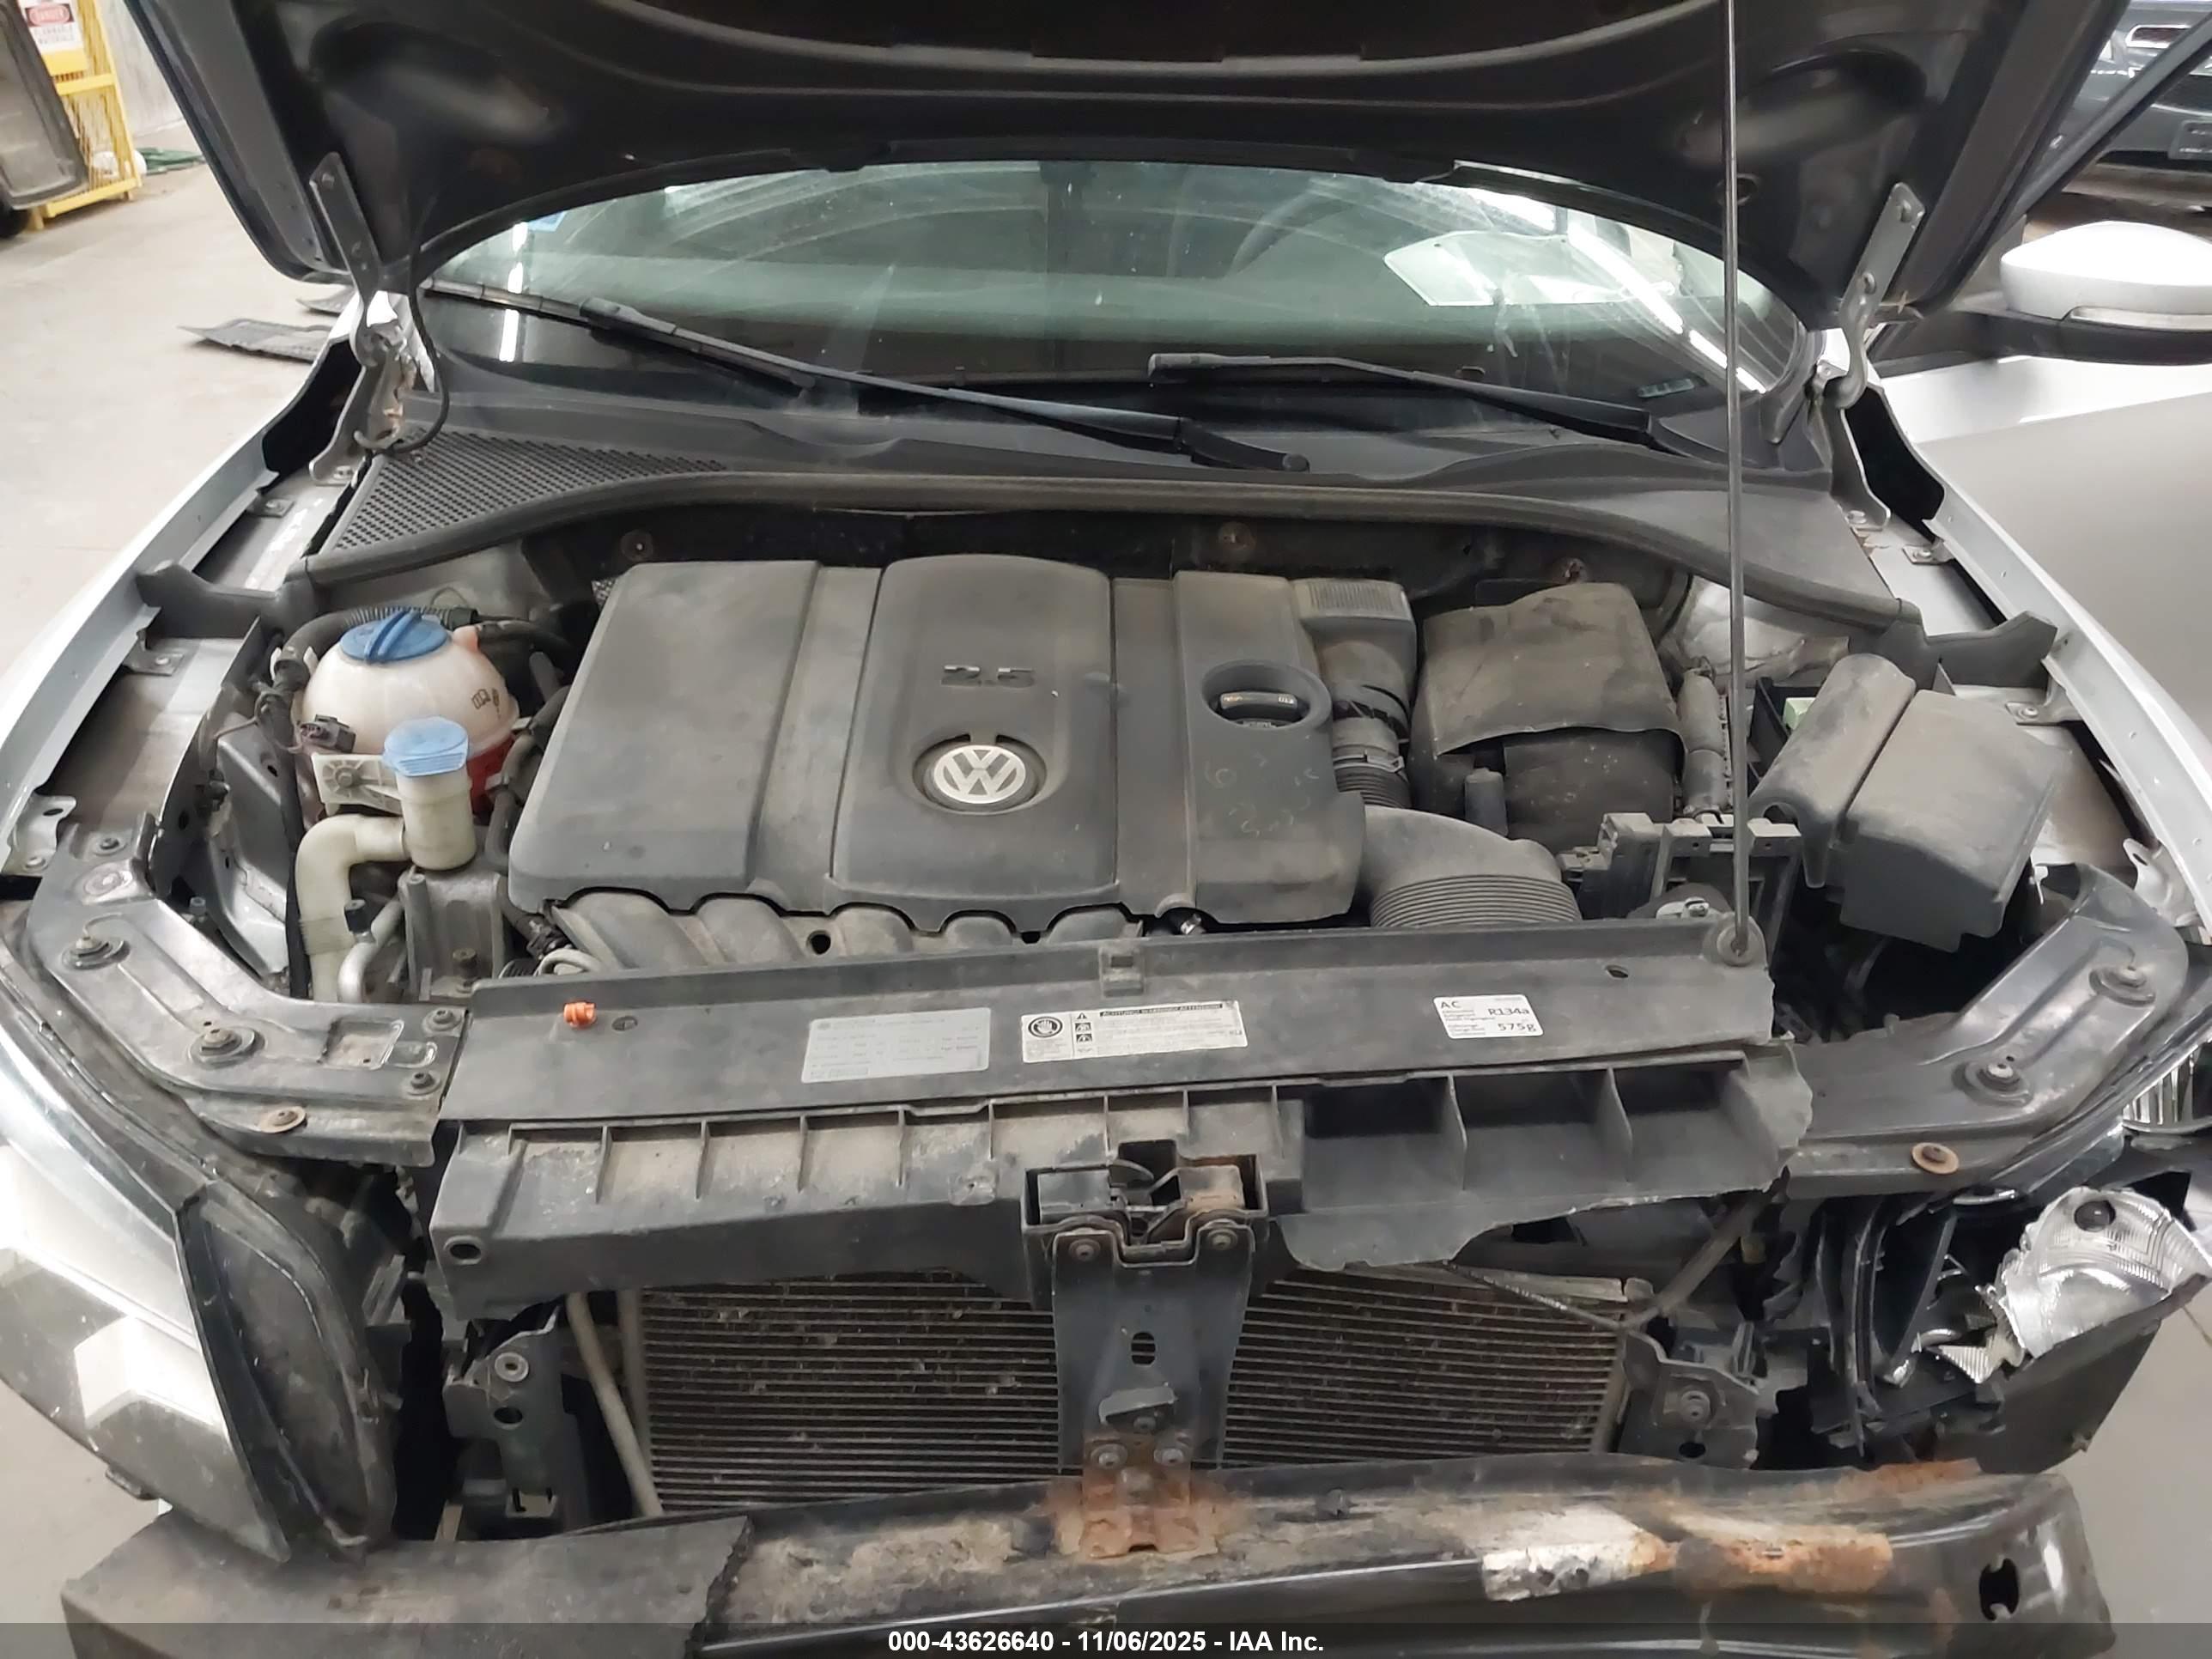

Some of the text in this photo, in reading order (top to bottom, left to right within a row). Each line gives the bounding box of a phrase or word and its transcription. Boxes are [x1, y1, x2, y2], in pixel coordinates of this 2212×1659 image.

[934, 744, 1027, 805] VW
[1440, 1000, 1462, 1009] AC
[1487, 1007, 1530, 1016] R134a
